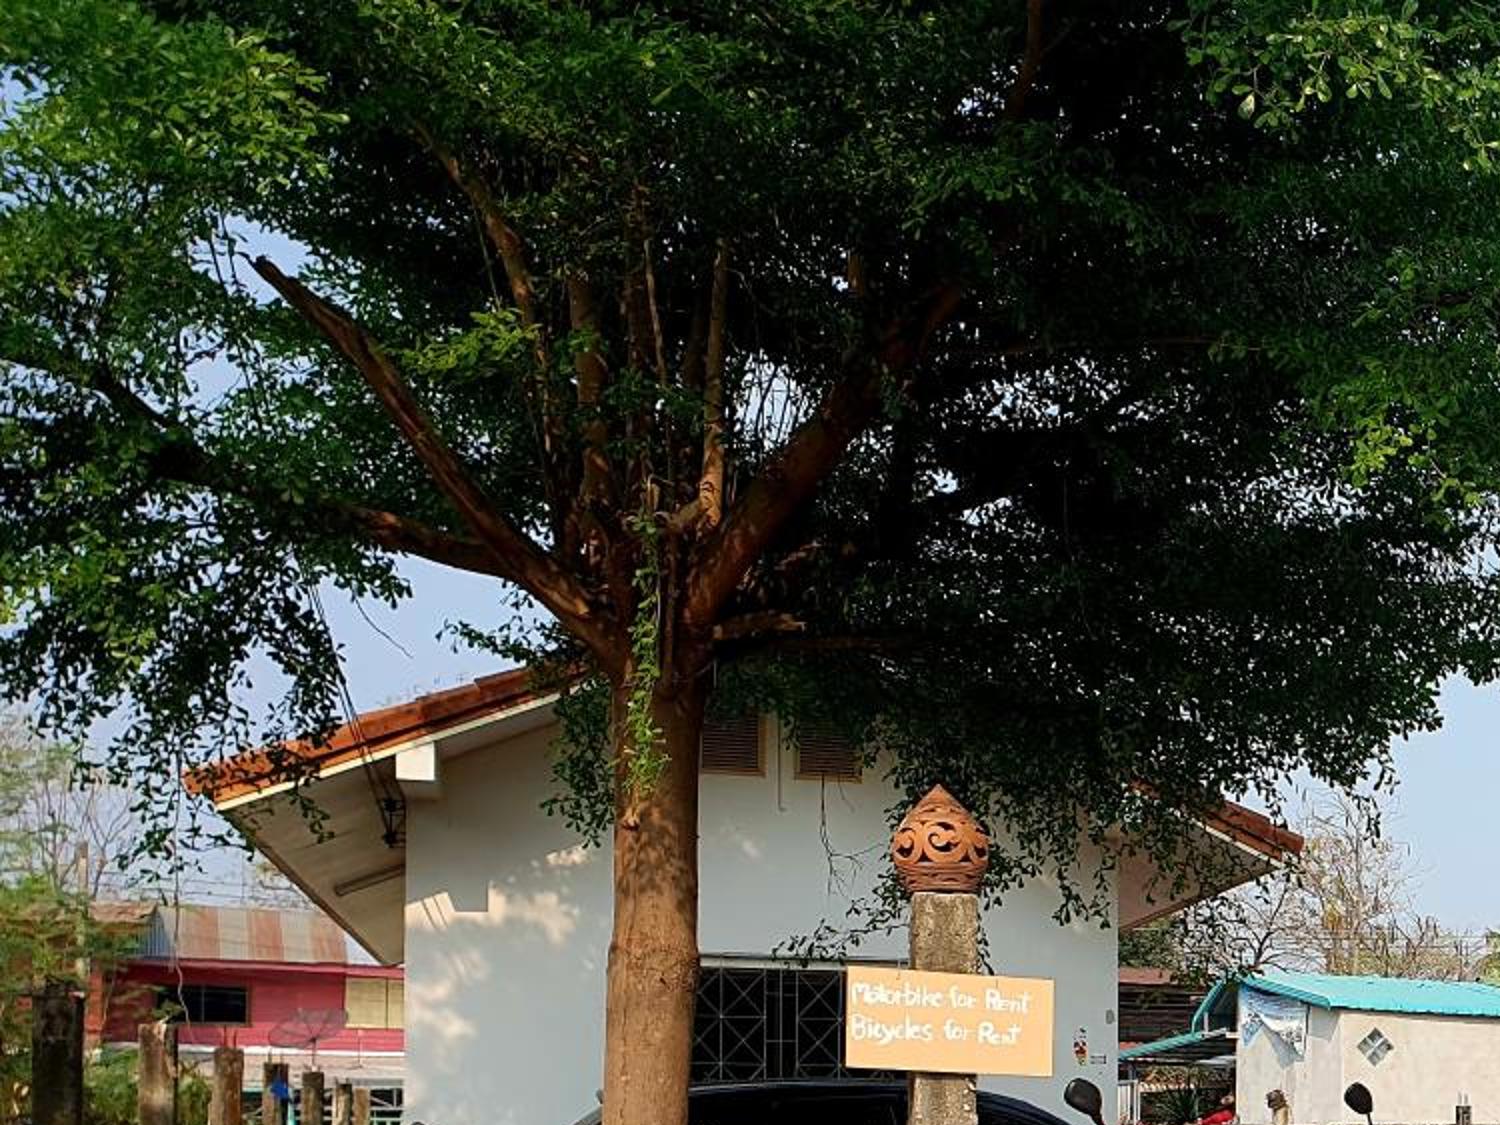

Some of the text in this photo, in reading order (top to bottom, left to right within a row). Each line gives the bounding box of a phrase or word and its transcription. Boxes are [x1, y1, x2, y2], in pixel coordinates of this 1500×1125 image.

[852, 982, 943, 1007] Motorbike
[950, 986, 975, 1008] for
[851, 1013, 1021, 1045] Bicycles for Rent
